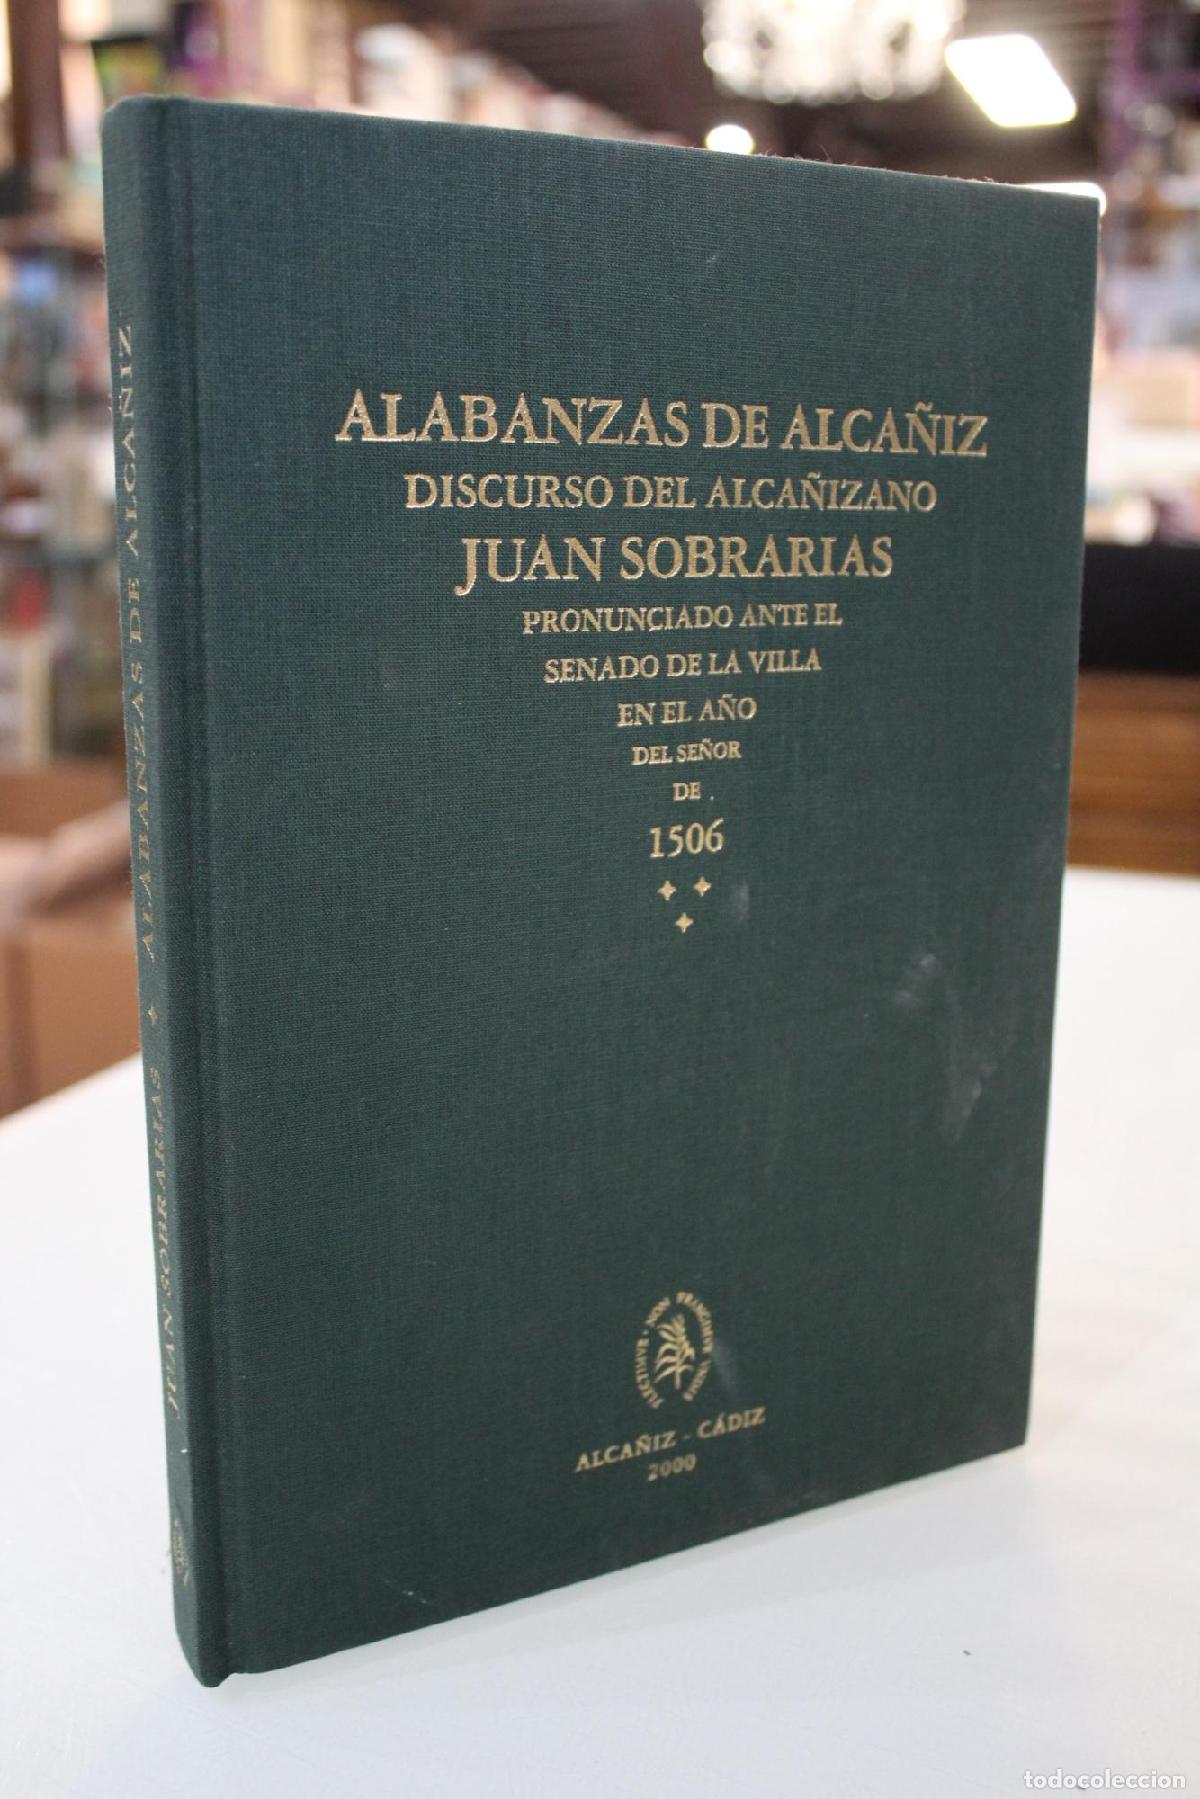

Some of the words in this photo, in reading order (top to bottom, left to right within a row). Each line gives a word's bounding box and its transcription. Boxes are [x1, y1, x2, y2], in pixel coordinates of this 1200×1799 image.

[118, 325, 140, 559] ALCAÑIZ
[335, 389, 690, 446] ALABANZAS
[702, 402, 769, 448] DE
[780, 402, 988, 457] ALCAÑIZ
[404, 474, 613, 508] DISCURSO
[623, 475, 696, 508] DEL
[705, 472, 937, 512] ALCAÑIZANO
[454, 534, 606, 596] JUAN
[620, 534, 893, 580] SOBRARIAS
[127, 577, 143, 644] DE
[522, 604, 734, 634] PRONUNCIADO
[739, 604, 808, 628] ANTE
[814, 603, 843, 626] EL
[543, 654, 660, 683] SENADO
[666, 654, 702, 677] DE
[708, 650, 742, 675] LA
[748, 648, 821, 674] VILLA
[617, 702, 656, 727] EN
[661, 701, 692, 724] EL
[698, 694, 757, 721] AÑO
[631, 746, 673, 765] DEL
[676, 738, 742, 763] SEÑOR
[673, 782, 701, 801] DE
[649, 818, 724, 858] 1506
[575, 1430, 678, 1473] ALCAÑIZ
[696, 1406, 766, 1439] CÁDIZ
[647, 1453, 697, 1482] 2000
